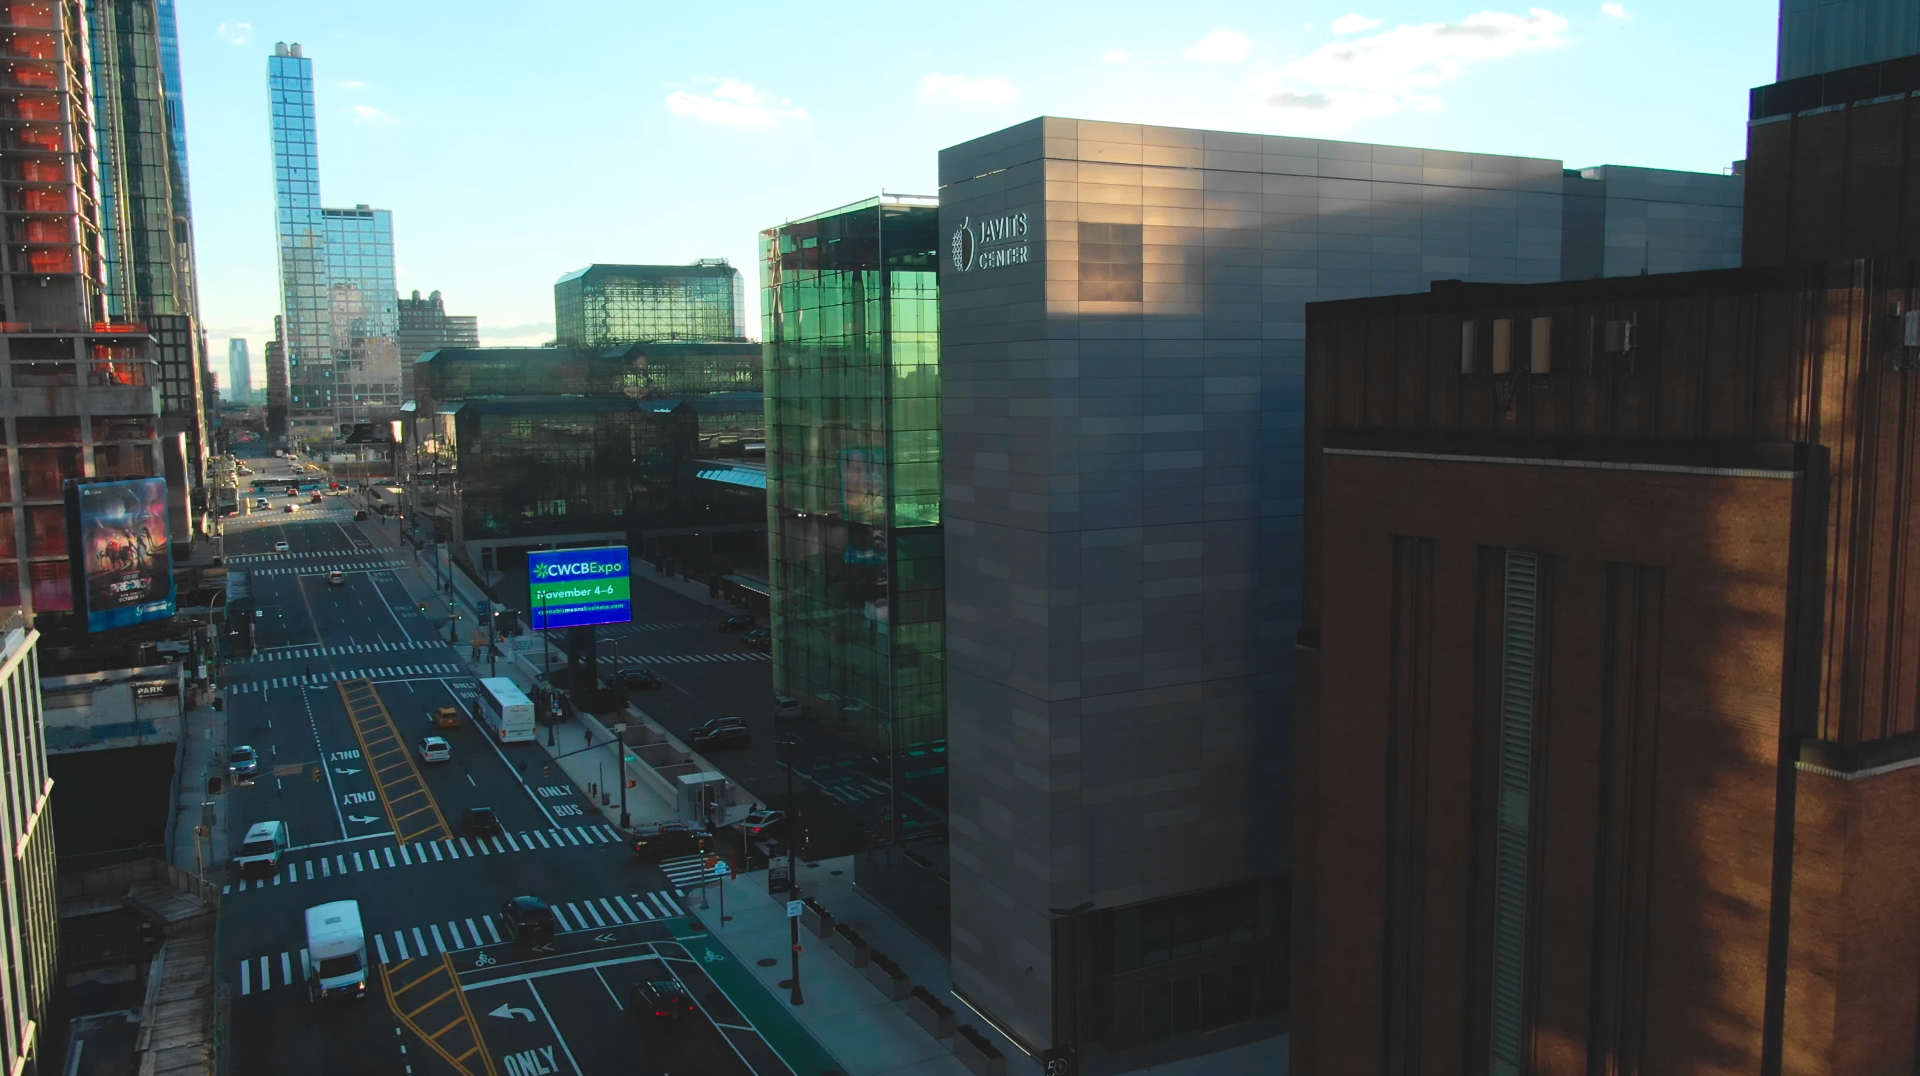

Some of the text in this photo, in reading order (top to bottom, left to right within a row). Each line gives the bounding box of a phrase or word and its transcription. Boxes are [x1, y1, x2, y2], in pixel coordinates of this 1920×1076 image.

[978, 212, 1028, 244] JAVITS
[979, 245, 1028, 270] CENTER
[548, 562, 622, 576] CWCBExpo
[537, 587, 592, 600] November
[137, 685, 164, 695] PARK
[330, 749, 360, 762] ONLY
[343, 790, 376, 805] ONLY
[537, 784, 573, 798] ONLY
[552, 804, 583, 817] BUS
[503, 1045, 560, 1076] ONLY
